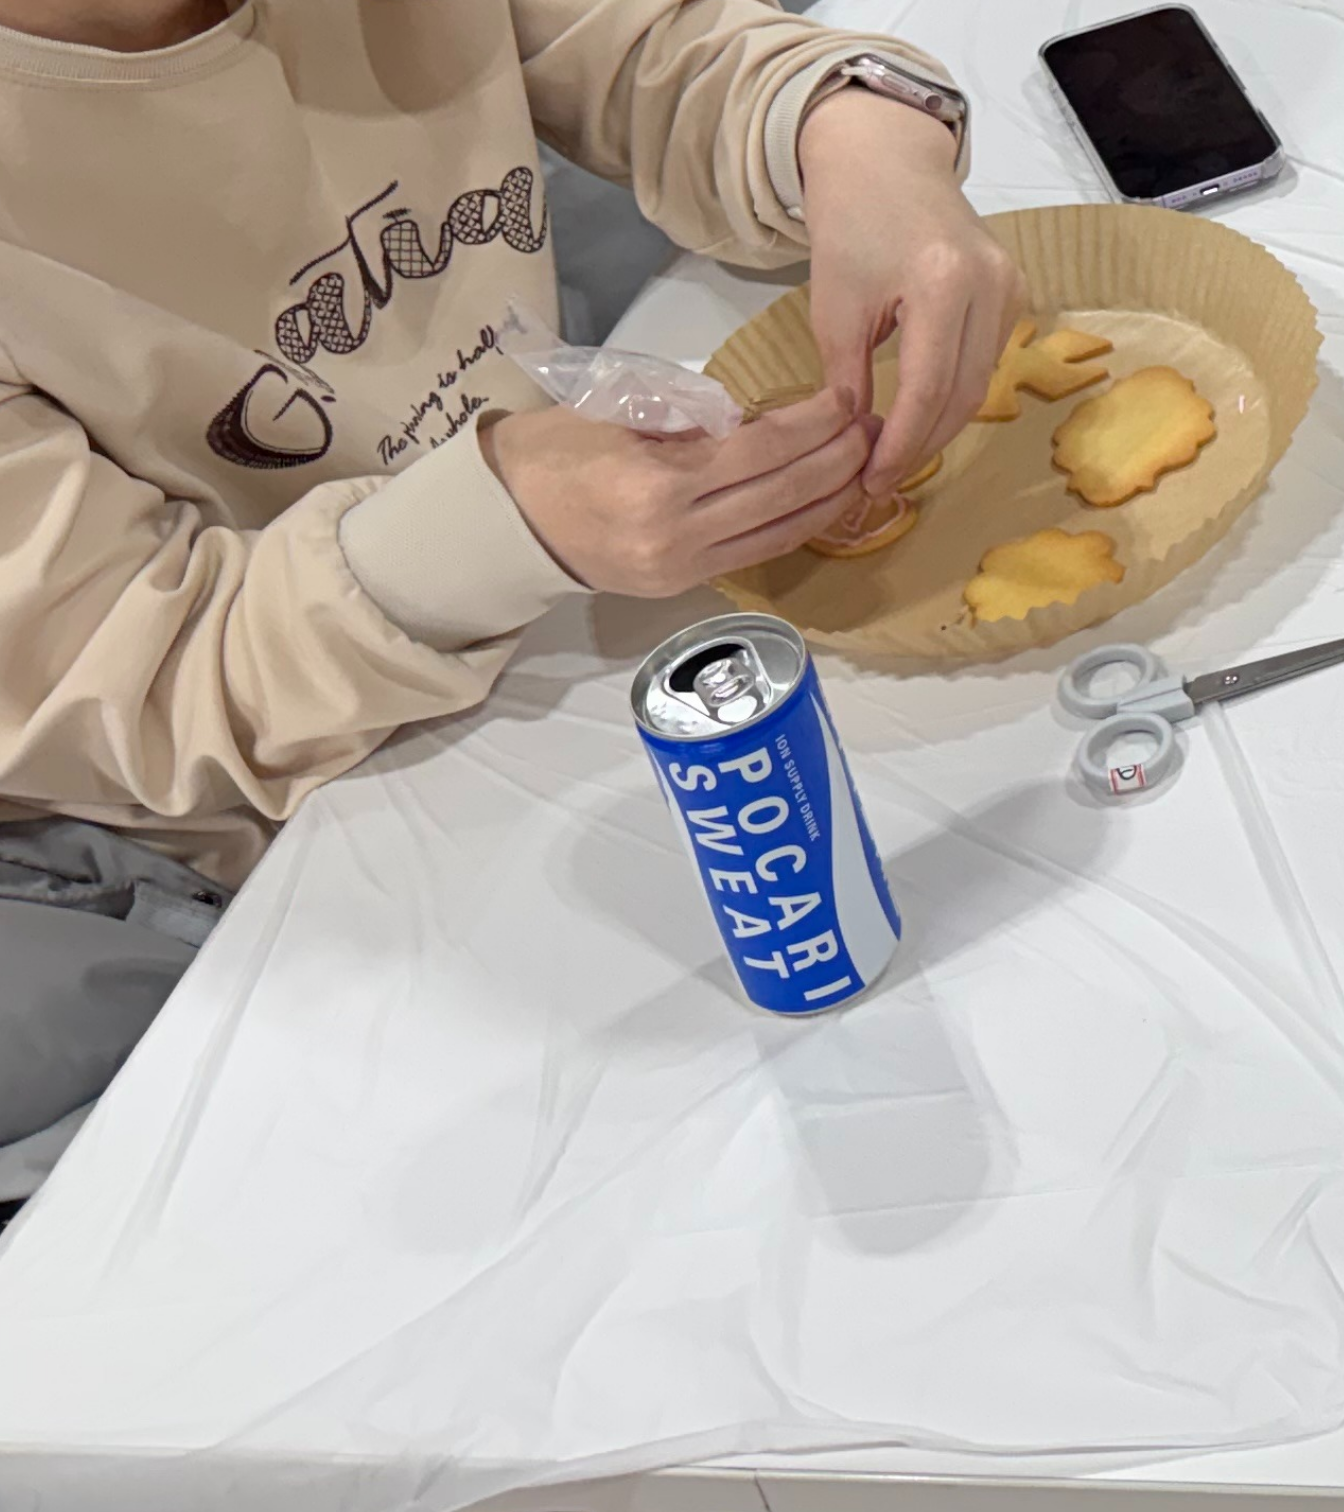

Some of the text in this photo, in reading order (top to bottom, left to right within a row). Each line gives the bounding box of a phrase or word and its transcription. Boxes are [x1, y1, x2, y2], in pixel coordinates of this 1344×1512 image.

[669, 762, 790, 980] SWEAT
[718, 746, 852, 1002] POCARI
[775, 734, 820, 842] ION SUPPLY DRINK
